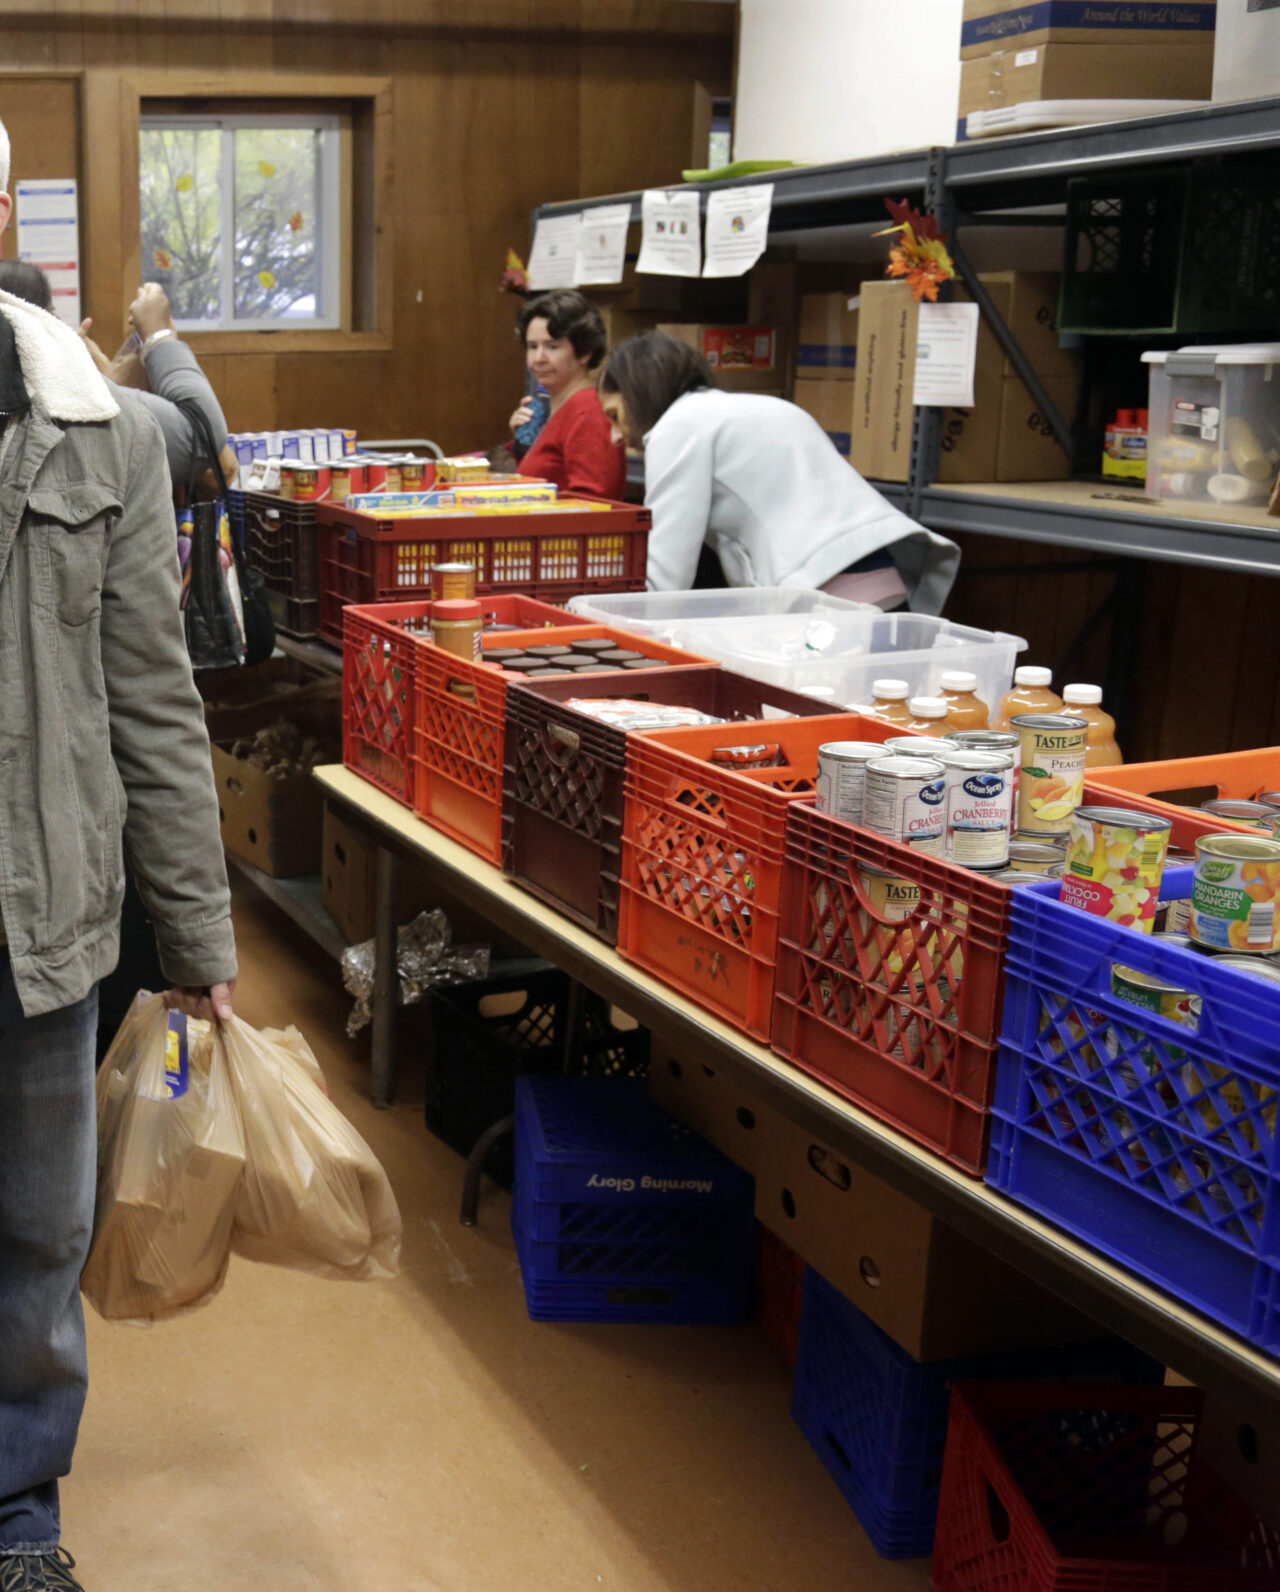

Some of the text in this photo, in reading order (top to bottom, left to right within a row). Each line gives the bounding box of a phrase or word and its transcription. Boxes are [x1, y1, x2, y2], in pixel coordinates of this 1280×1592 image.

[1081, 7, 1200, 23] Around the World Values
[1034, 734, 1068, 749] TASTE
[921, 791, 938, 801] Ocean
[965, 781, 1003, 796] Ocean Spray
[908, 814, 944, 833] CRANBE
[953, 808, 1009, 823] CRANBERRY
[885, 883, 920, 899] TASTE
[1062, 883, 1101, 902] COCKTA
[1194, 880, 1244, 900] MANDARIN
[1063, 894, 1089, 909] FRUIT
[1194, 890, 1240, 910] ORANGES
[1126, 991, 1149, 1002] FRUIT
[586, 1173, 713, 1193] Morning Glory
